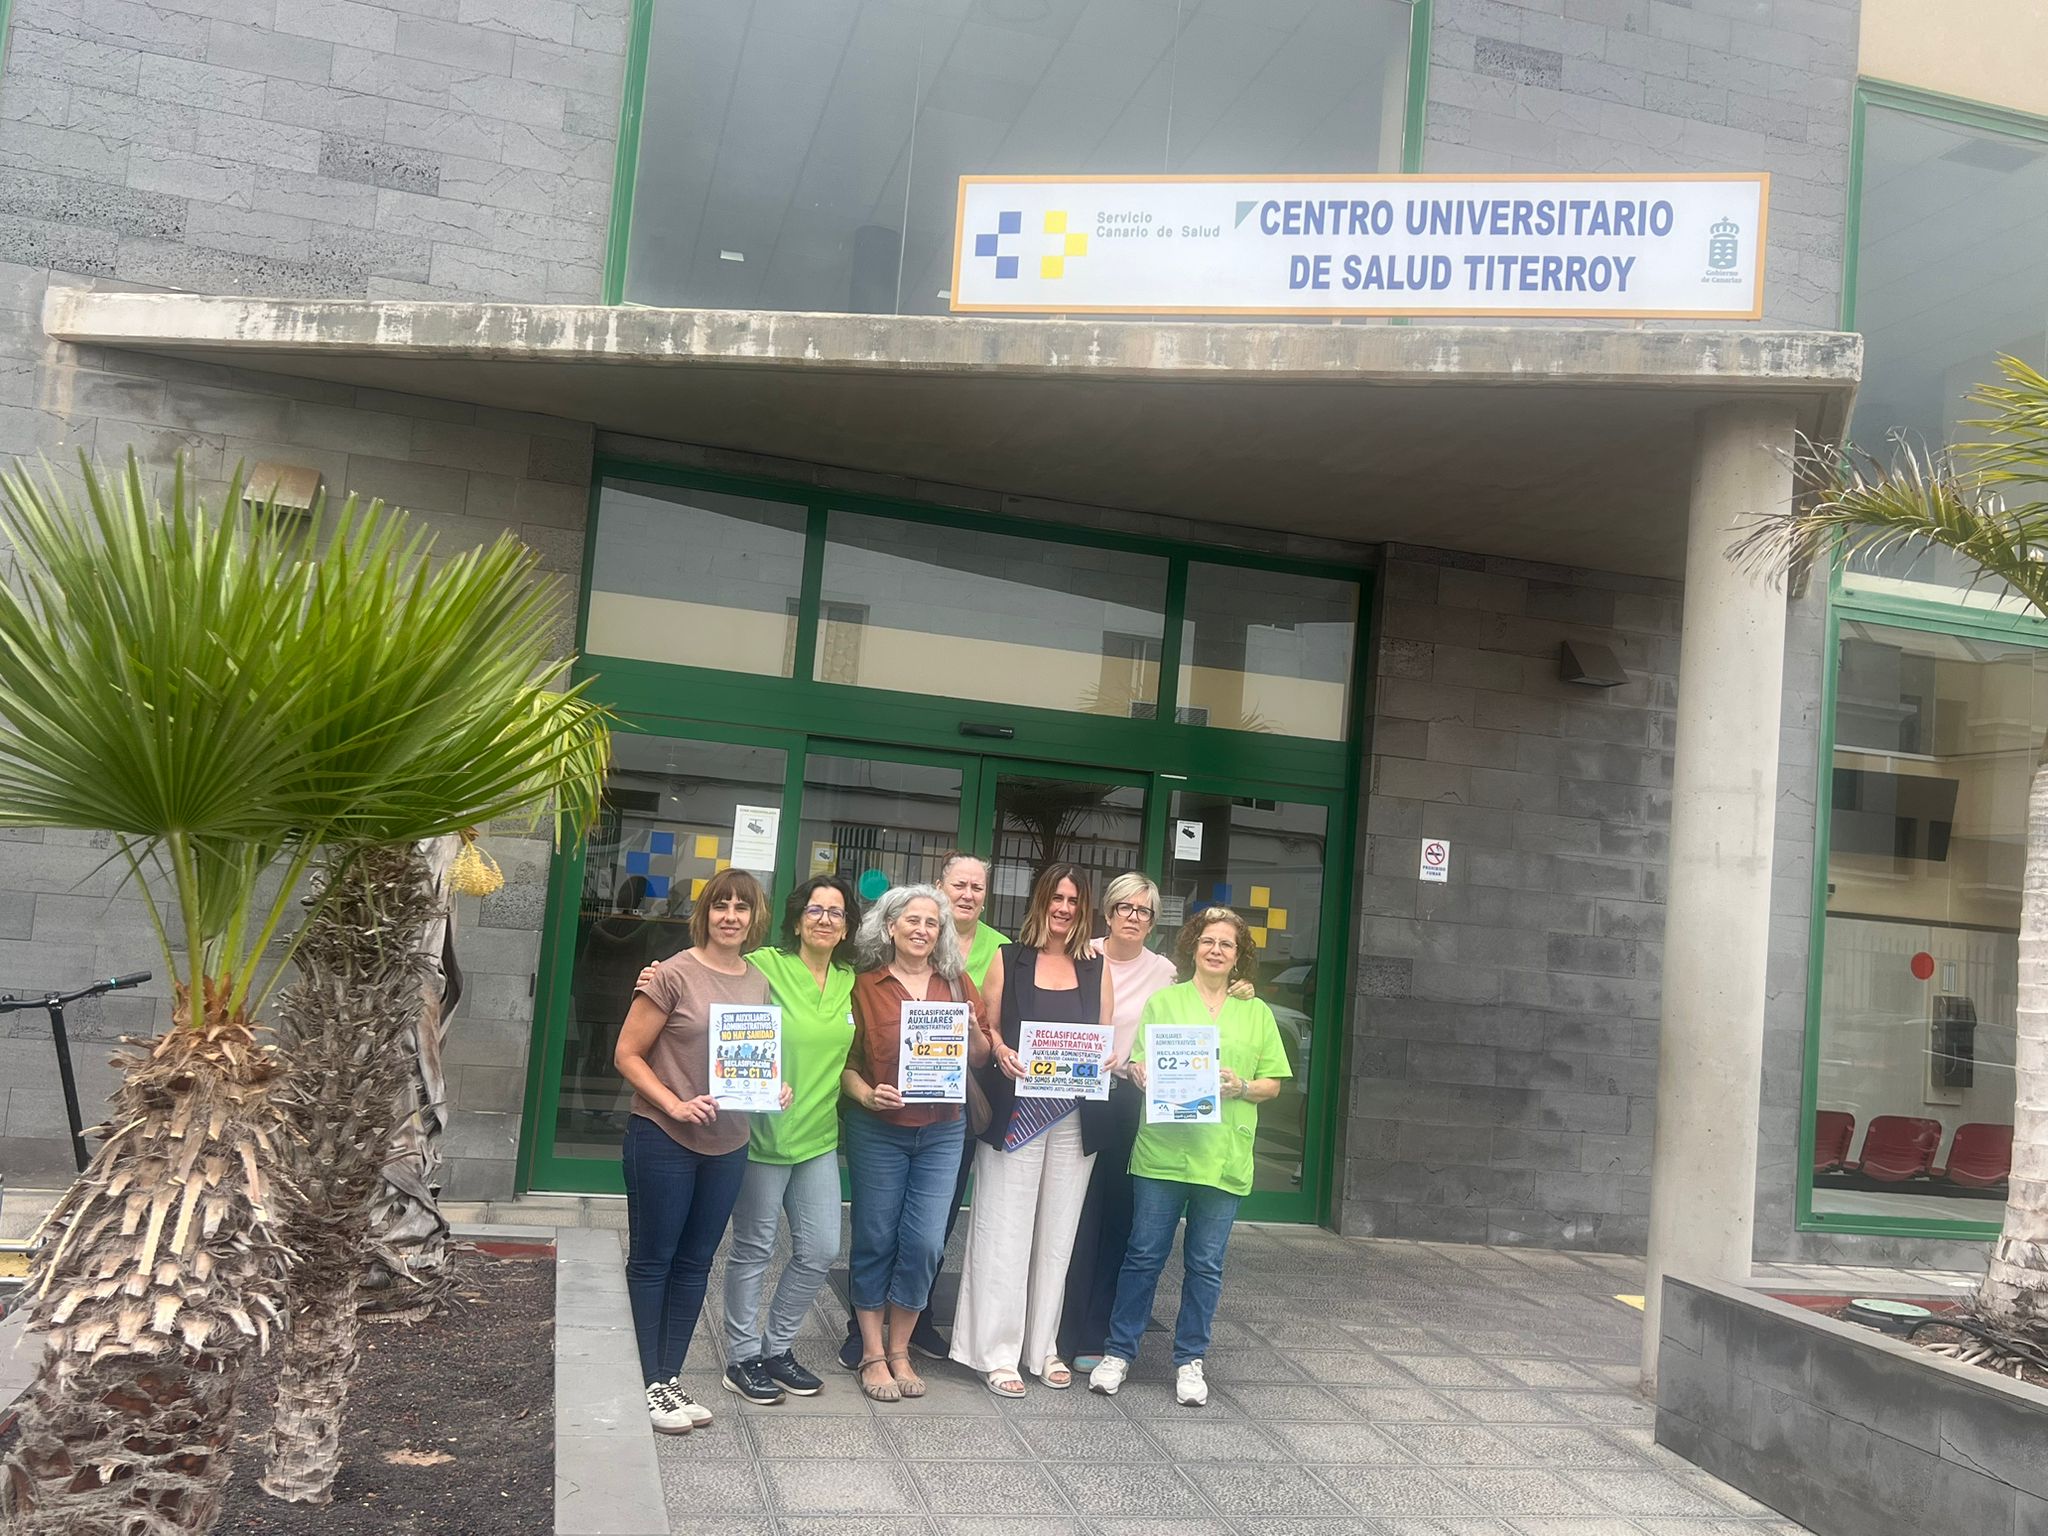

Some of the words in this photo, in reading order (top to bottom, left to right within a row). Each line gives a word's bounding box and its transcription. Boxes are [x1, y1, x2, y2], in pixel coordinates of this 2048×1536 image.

[1097, 211, 1153, 223] Servicio
[1260, 200, 1394, 236] CENTRO
[1406, 200, 1674, 237] UNIVERSITARIO
[1096, 225, 1149, 237] Canario
[1157, 225, 1173, 237] de
[1181, 225, 1220, 237] Salud
[1289, 255, 1332, 290] DE
[1342, 255, 1452, 291] SALUD
[1464, 255, 1636, 292] TITERROY
[724, 1013, 735, 1022] SIN
[953, 1023, 964, 1034] YA
[722, 1031, 732, 1040] NO
[733, 1030, 745, 1040] HAY
[917, 1044, 930, 1056] C2
[946, 1044, 958, 1056] C1
[1032, 1039, 1092, 1050] ADMINISTRATIVA
[1061, 1051, 1101, 1059] ADMINISTRATIVO
[1034, 1062, 1052, 1074] C2
[1077, 1064, 1094, 1077] C1
[1158, 1057, 1177, 1070] C2
[1192, 1057, 1209, 1070] C1
[724, 1067, 737, 1078] C2
[749, 1067, 760, 1078] C1
[762, 1069, 772, 1078] YA
